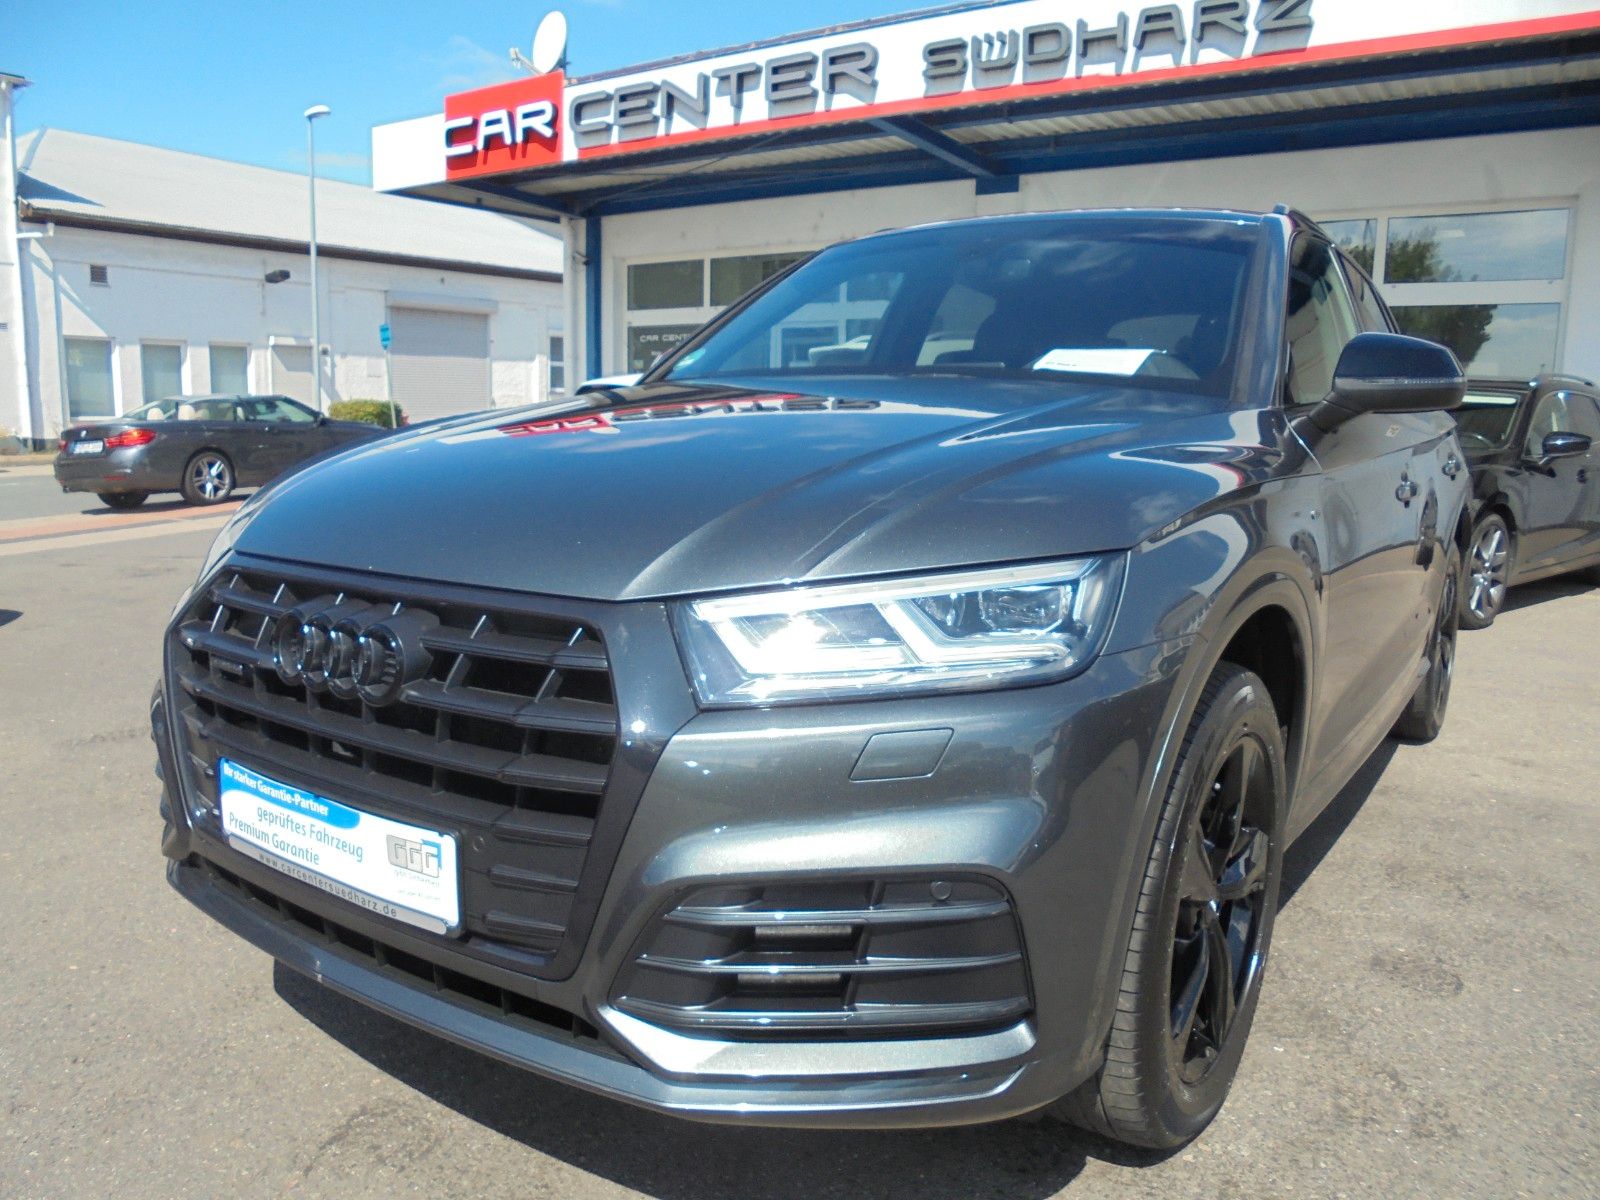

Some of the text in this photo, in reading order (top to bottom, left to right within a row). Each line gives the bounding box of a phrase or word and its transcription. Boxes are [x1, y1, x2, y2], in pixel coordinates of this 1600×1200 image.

[444, 101, 556, 157] CAR
[569, 41, 880, 136] CENTER
[257, 779, 329, 816] Garantie-Partner
[229, 812, 320, 865] Premium Garantie
[257, 807, 363, 862] geprüftes Fahrzeug
[259, 853, 397, 917] www.carcentersuedharz.de
